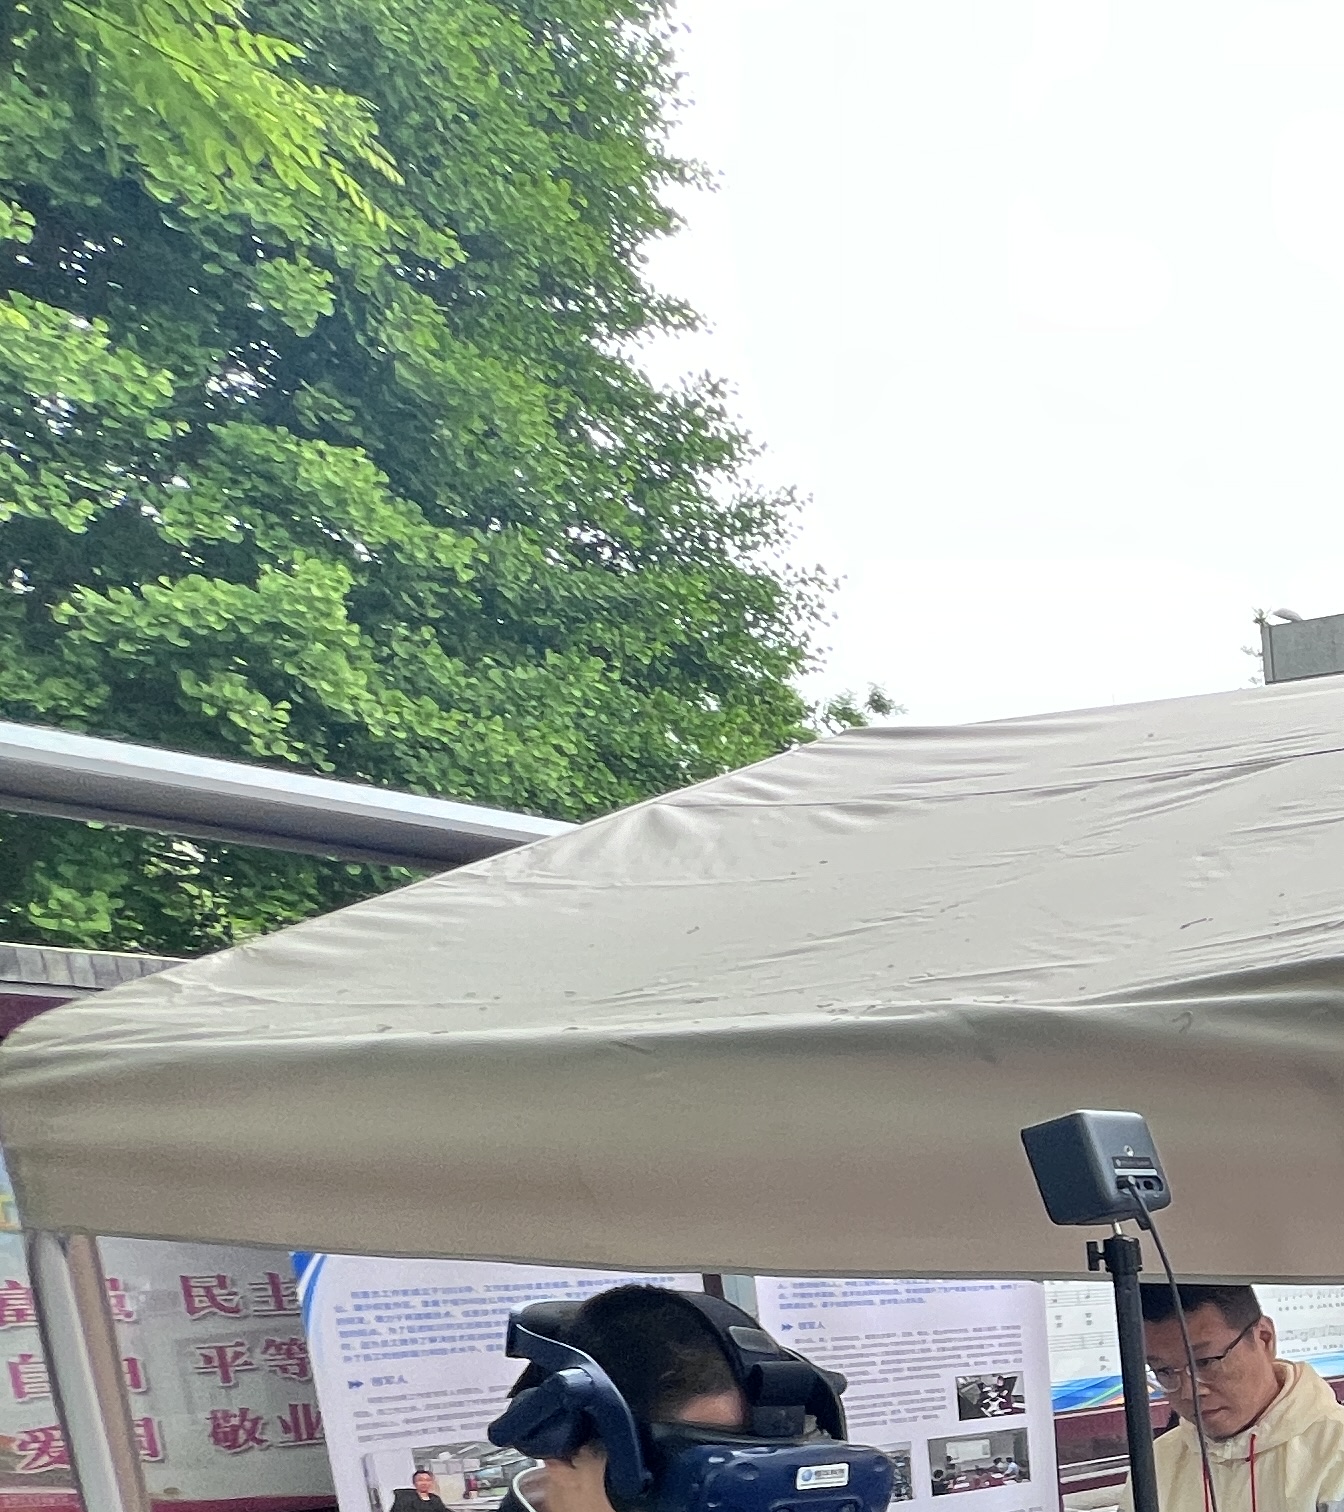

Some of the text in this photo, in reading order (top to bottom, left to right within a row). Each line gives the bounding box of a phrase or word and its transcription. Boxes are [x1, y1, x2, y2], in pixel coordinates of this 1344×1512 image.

[179, 1272, 302, 1319] 民主
[194, 1336, 312, 1386] 平等
[206, 1403, 326, 1452] 敬业
